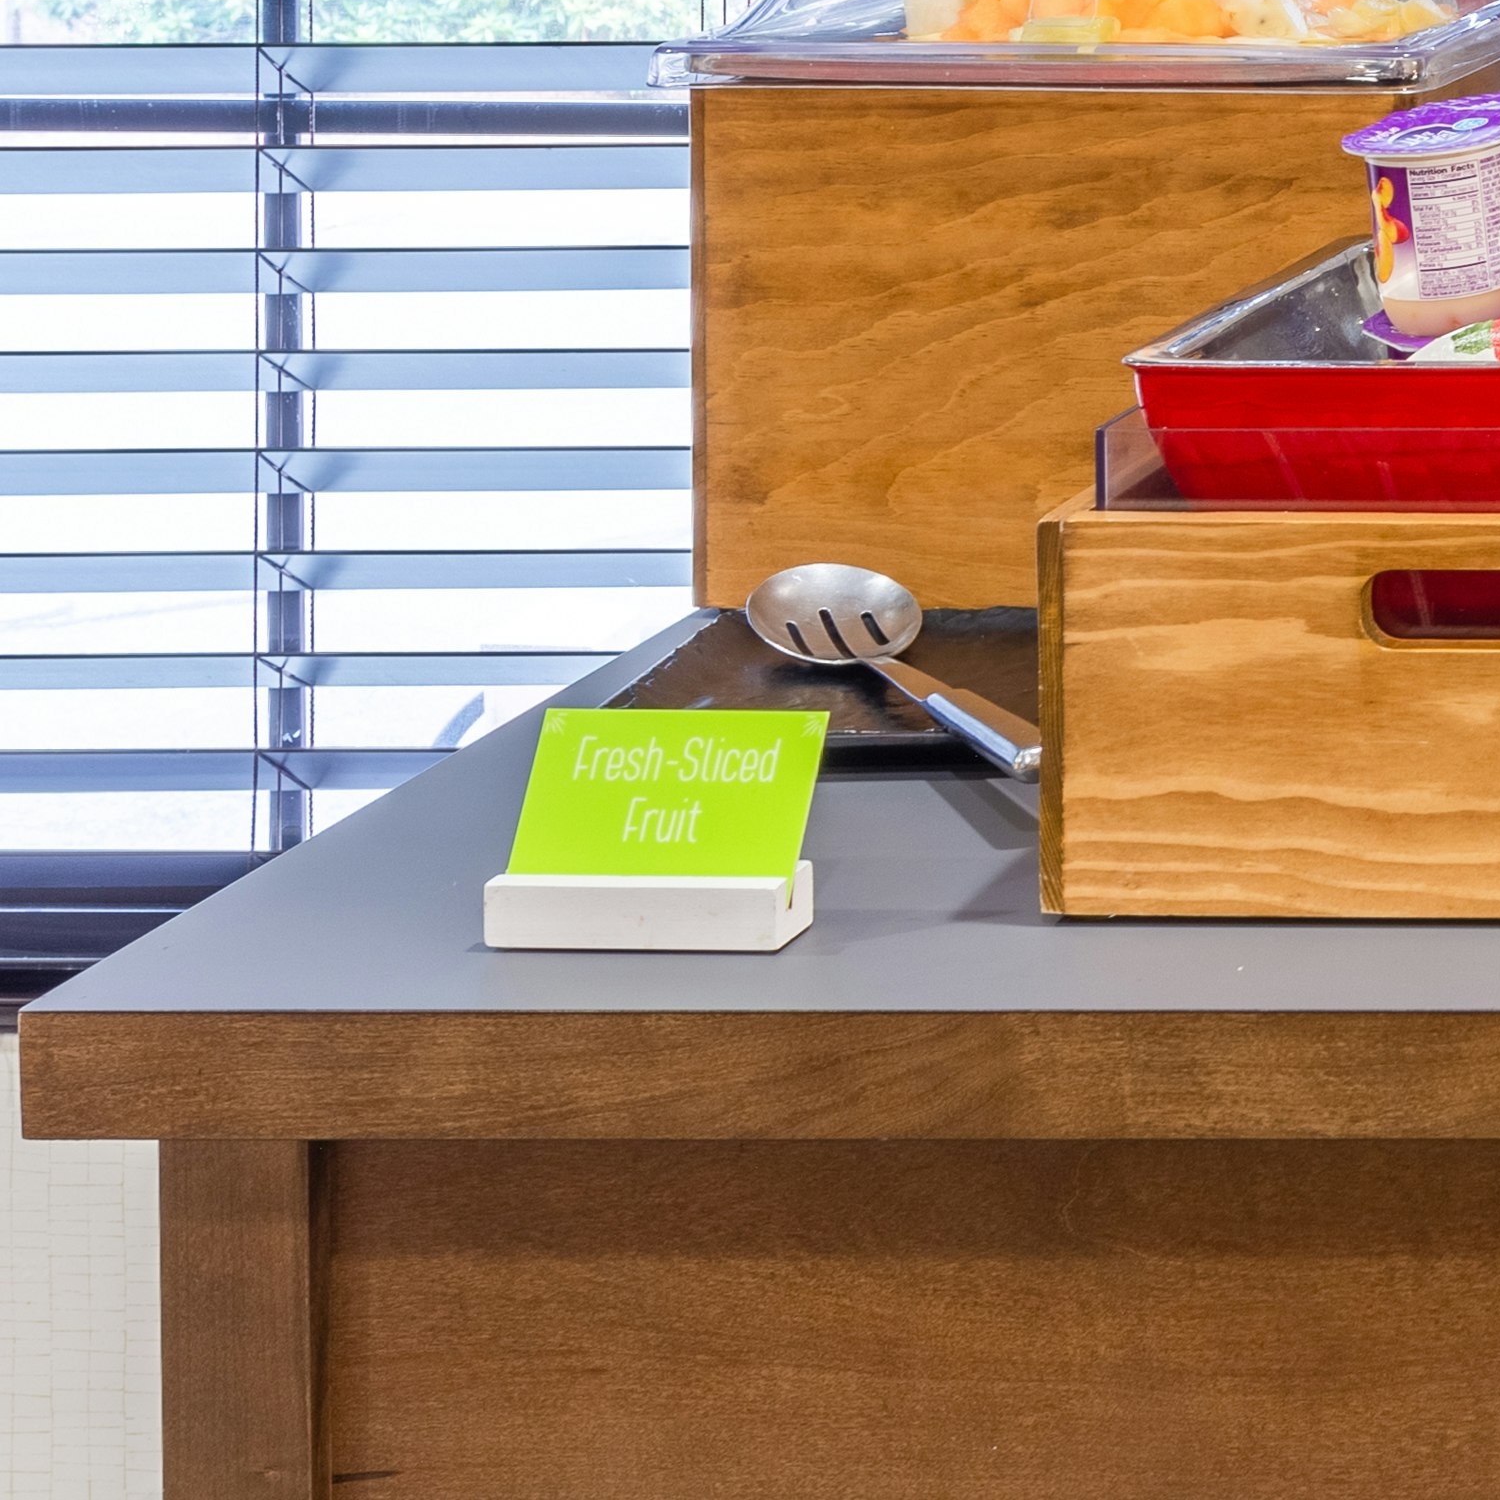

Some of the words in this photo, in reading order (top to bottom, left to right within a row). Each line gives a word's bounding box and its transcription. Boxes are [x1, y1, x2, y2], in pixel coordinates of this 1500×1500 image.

[1409, 167, 1448, 177] Nutrition
[1450, 163, 1475, 173] Facts
[572, 735, 782, 783] Fresh-Sliced
[622, 796, 702, 844] Fruit
